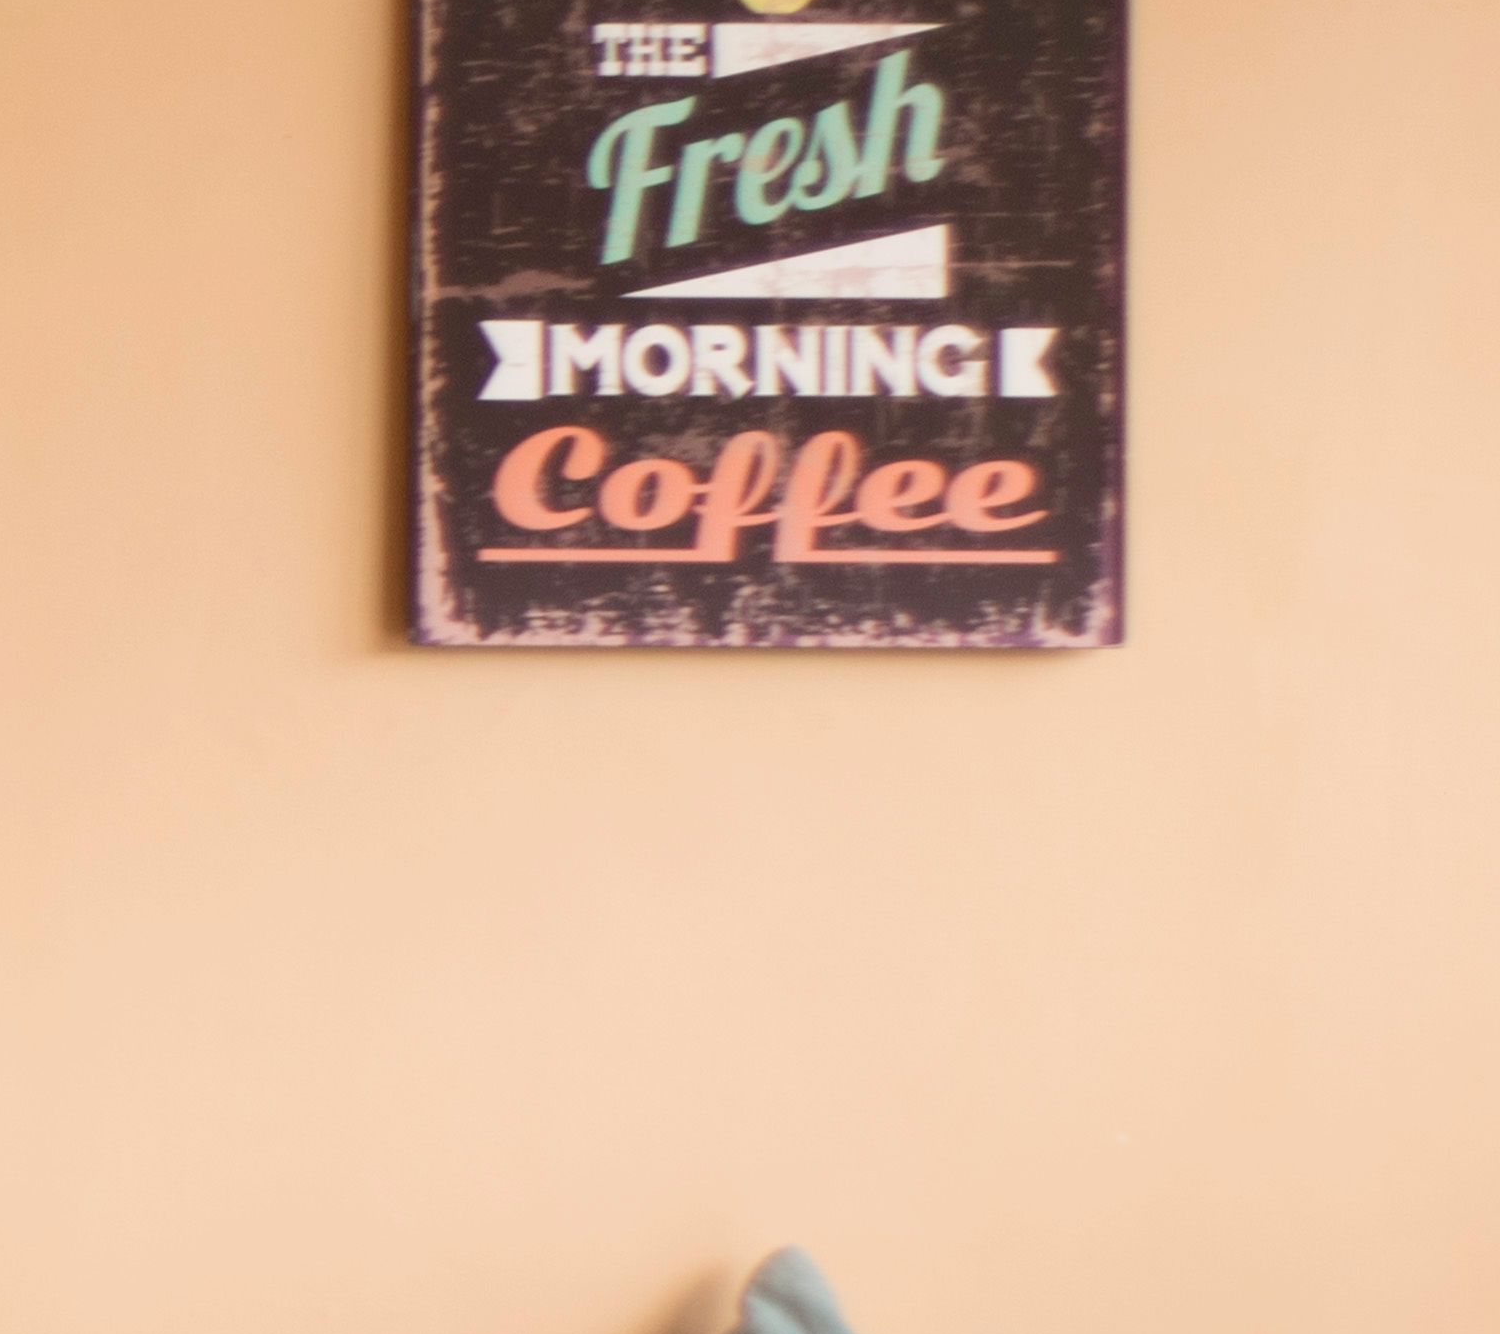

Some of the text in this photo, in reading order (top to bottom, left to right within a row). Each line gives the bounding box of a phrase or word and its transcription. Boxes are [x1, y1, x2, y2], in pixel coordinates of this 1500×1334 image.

[593, 22, 710, 77] THE
[585, 48, 948, 267] Fresh
[547, 324, 988, 400] MORNING
[495, 425, 1052, 564] Coffee
